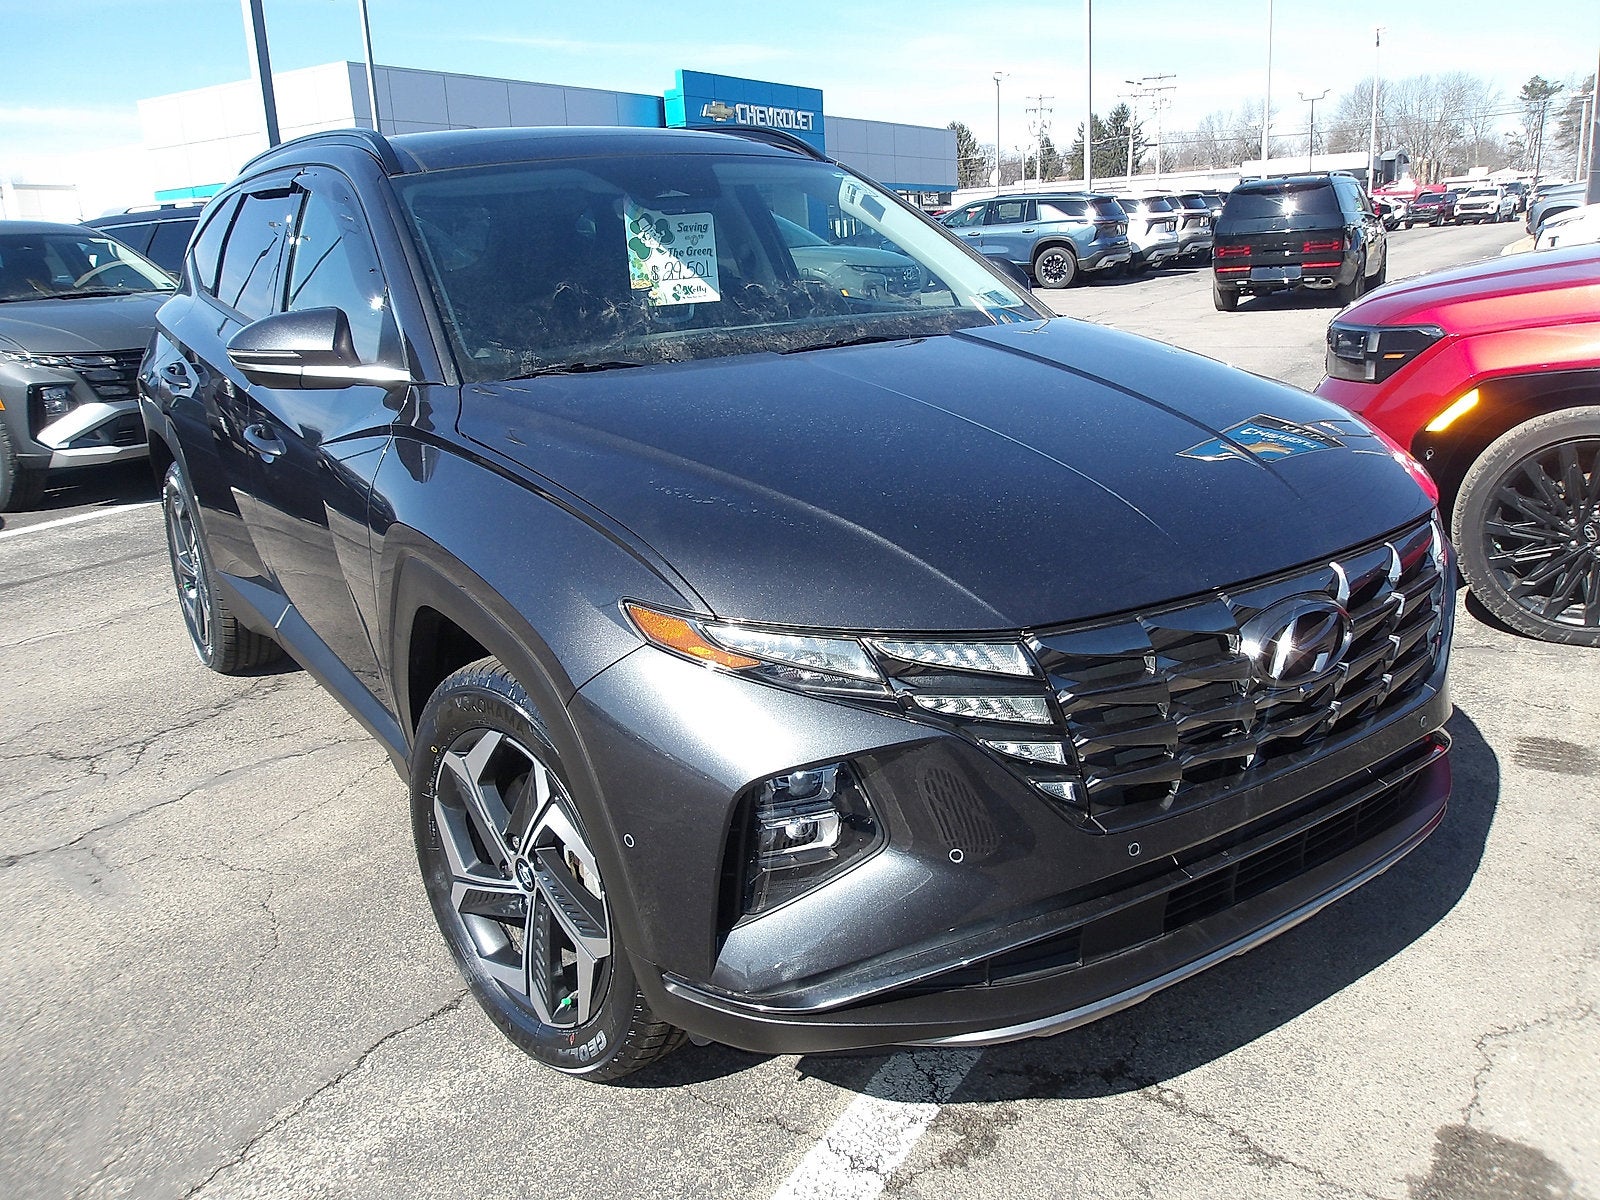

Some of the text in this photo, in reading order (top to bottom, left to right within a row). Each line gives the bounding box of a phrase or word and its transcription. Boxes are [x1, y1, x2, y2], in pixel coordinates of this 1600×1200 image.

[735, 103, 814, 131] CHEVROLET
[677, 222, 709, 233] Saving
[668, 246, 714, 259] The Green
